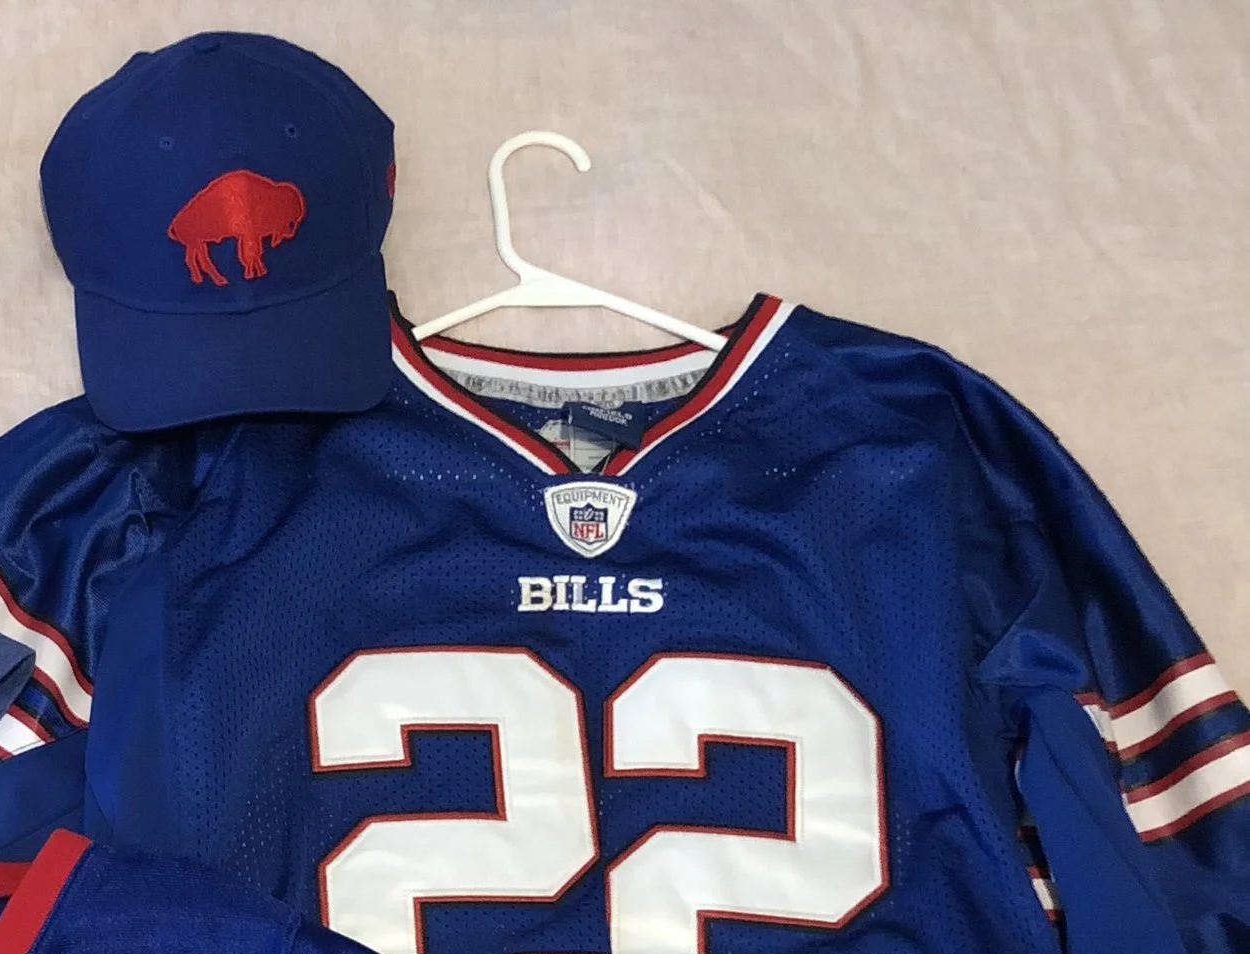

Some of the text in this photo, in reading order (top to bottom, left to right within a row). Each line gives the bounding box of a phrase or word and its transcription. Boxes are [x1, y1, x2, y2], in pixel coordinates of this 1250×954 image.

[555, 490, 624, 508] EQUIPMENT
[573, 523, 604, 539] NFL
[517, 575, 664, 613] BILLS
